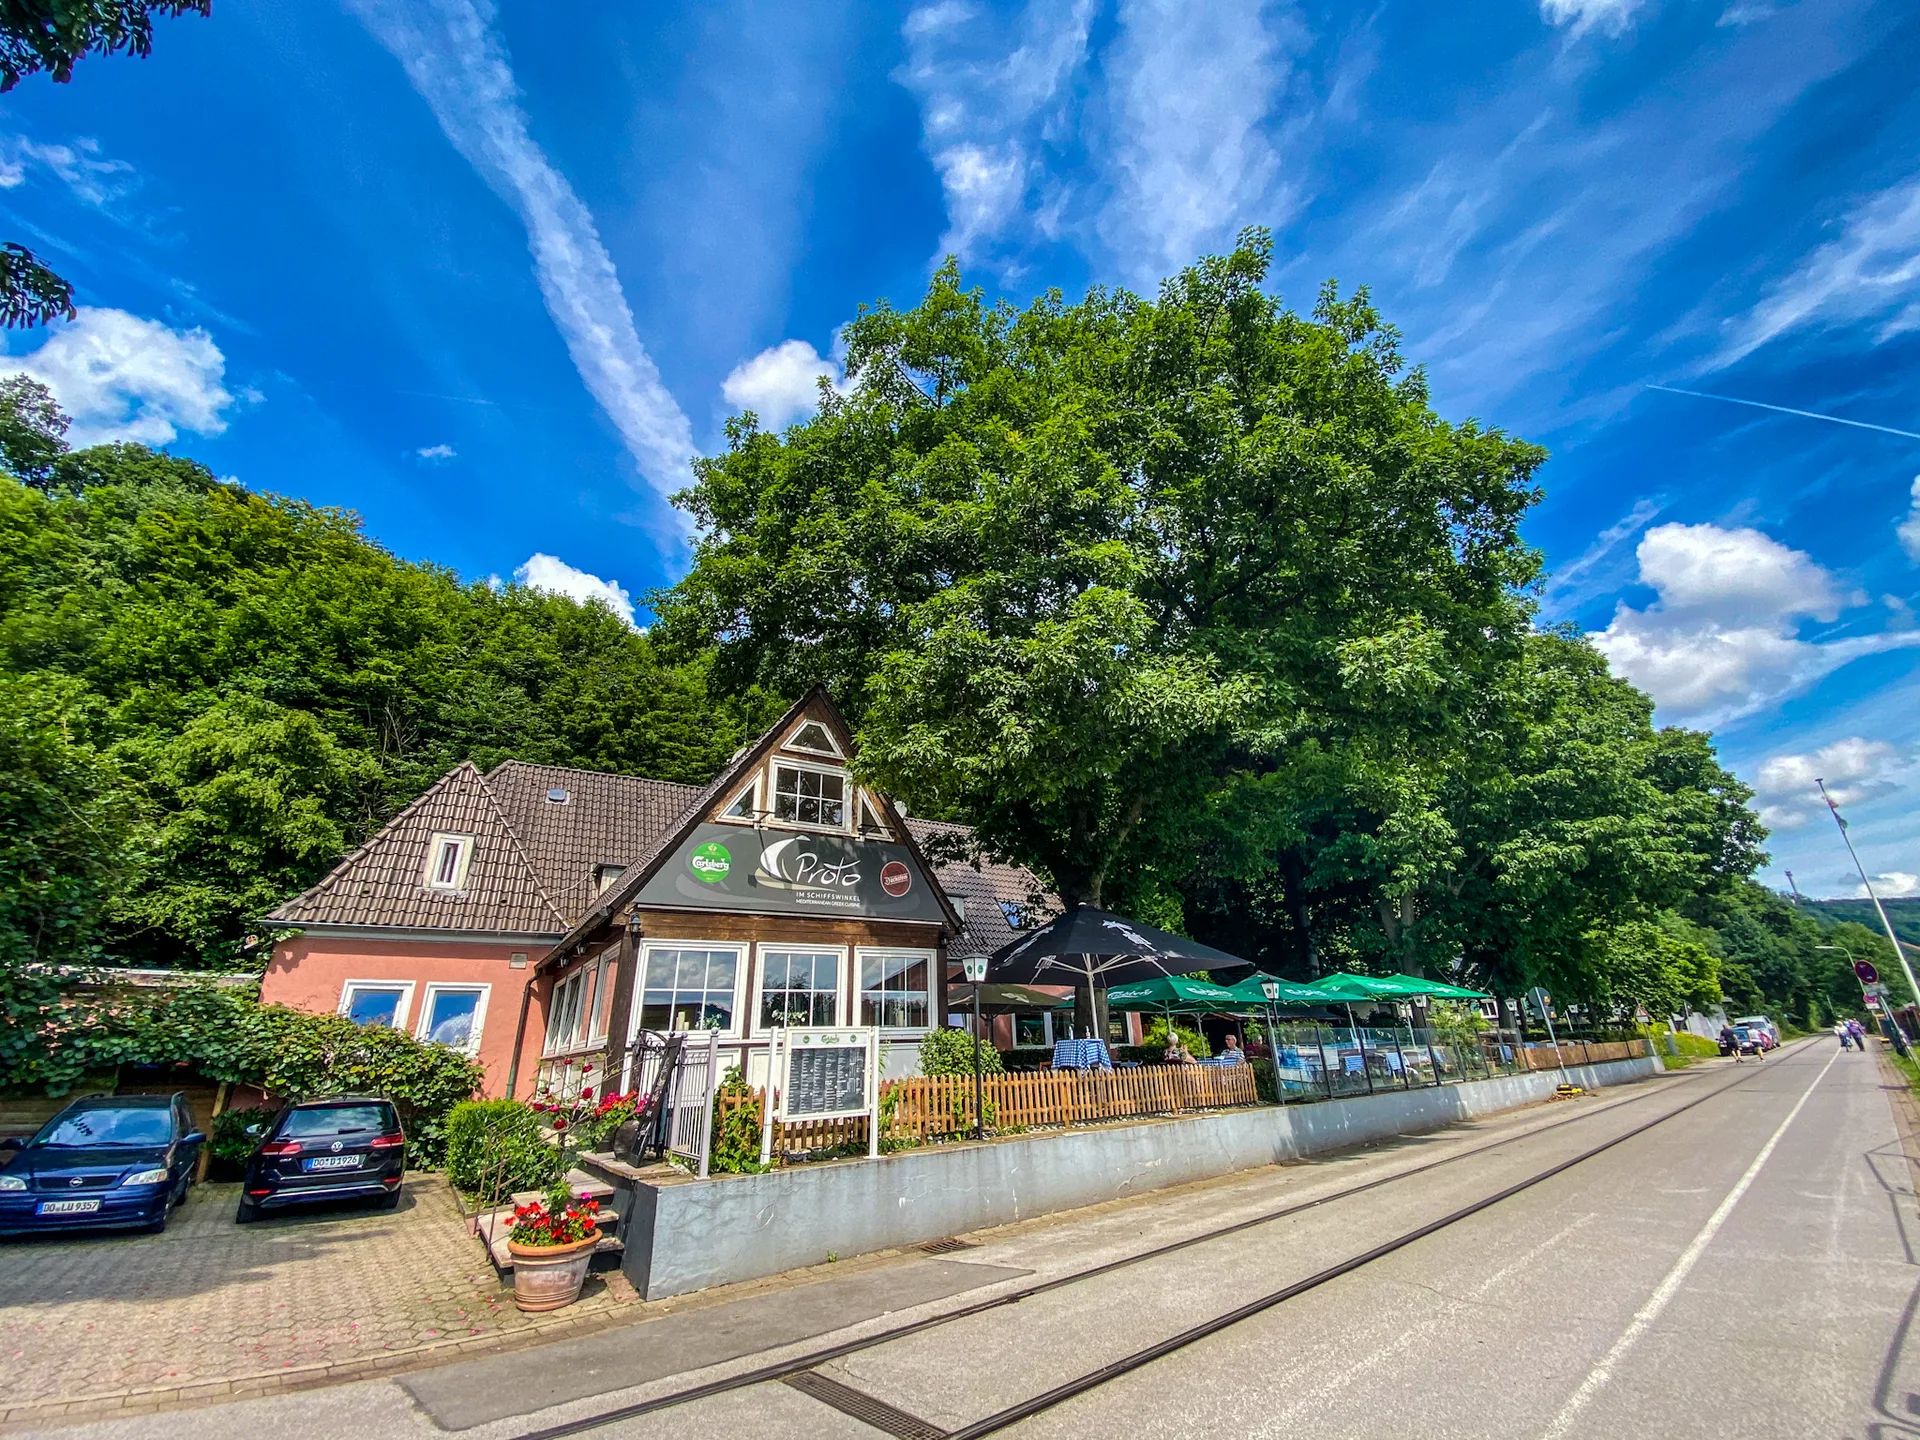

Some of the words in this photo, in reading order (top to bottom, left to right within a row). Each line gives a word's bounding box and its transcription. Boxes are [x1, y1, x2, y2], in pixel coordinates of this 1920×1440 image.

[692, 855, 730, 872] Carlsberg
[795, 852, 861, 886] Proto
[806, 892, 860, 902] SCHIFFSWINKEL
